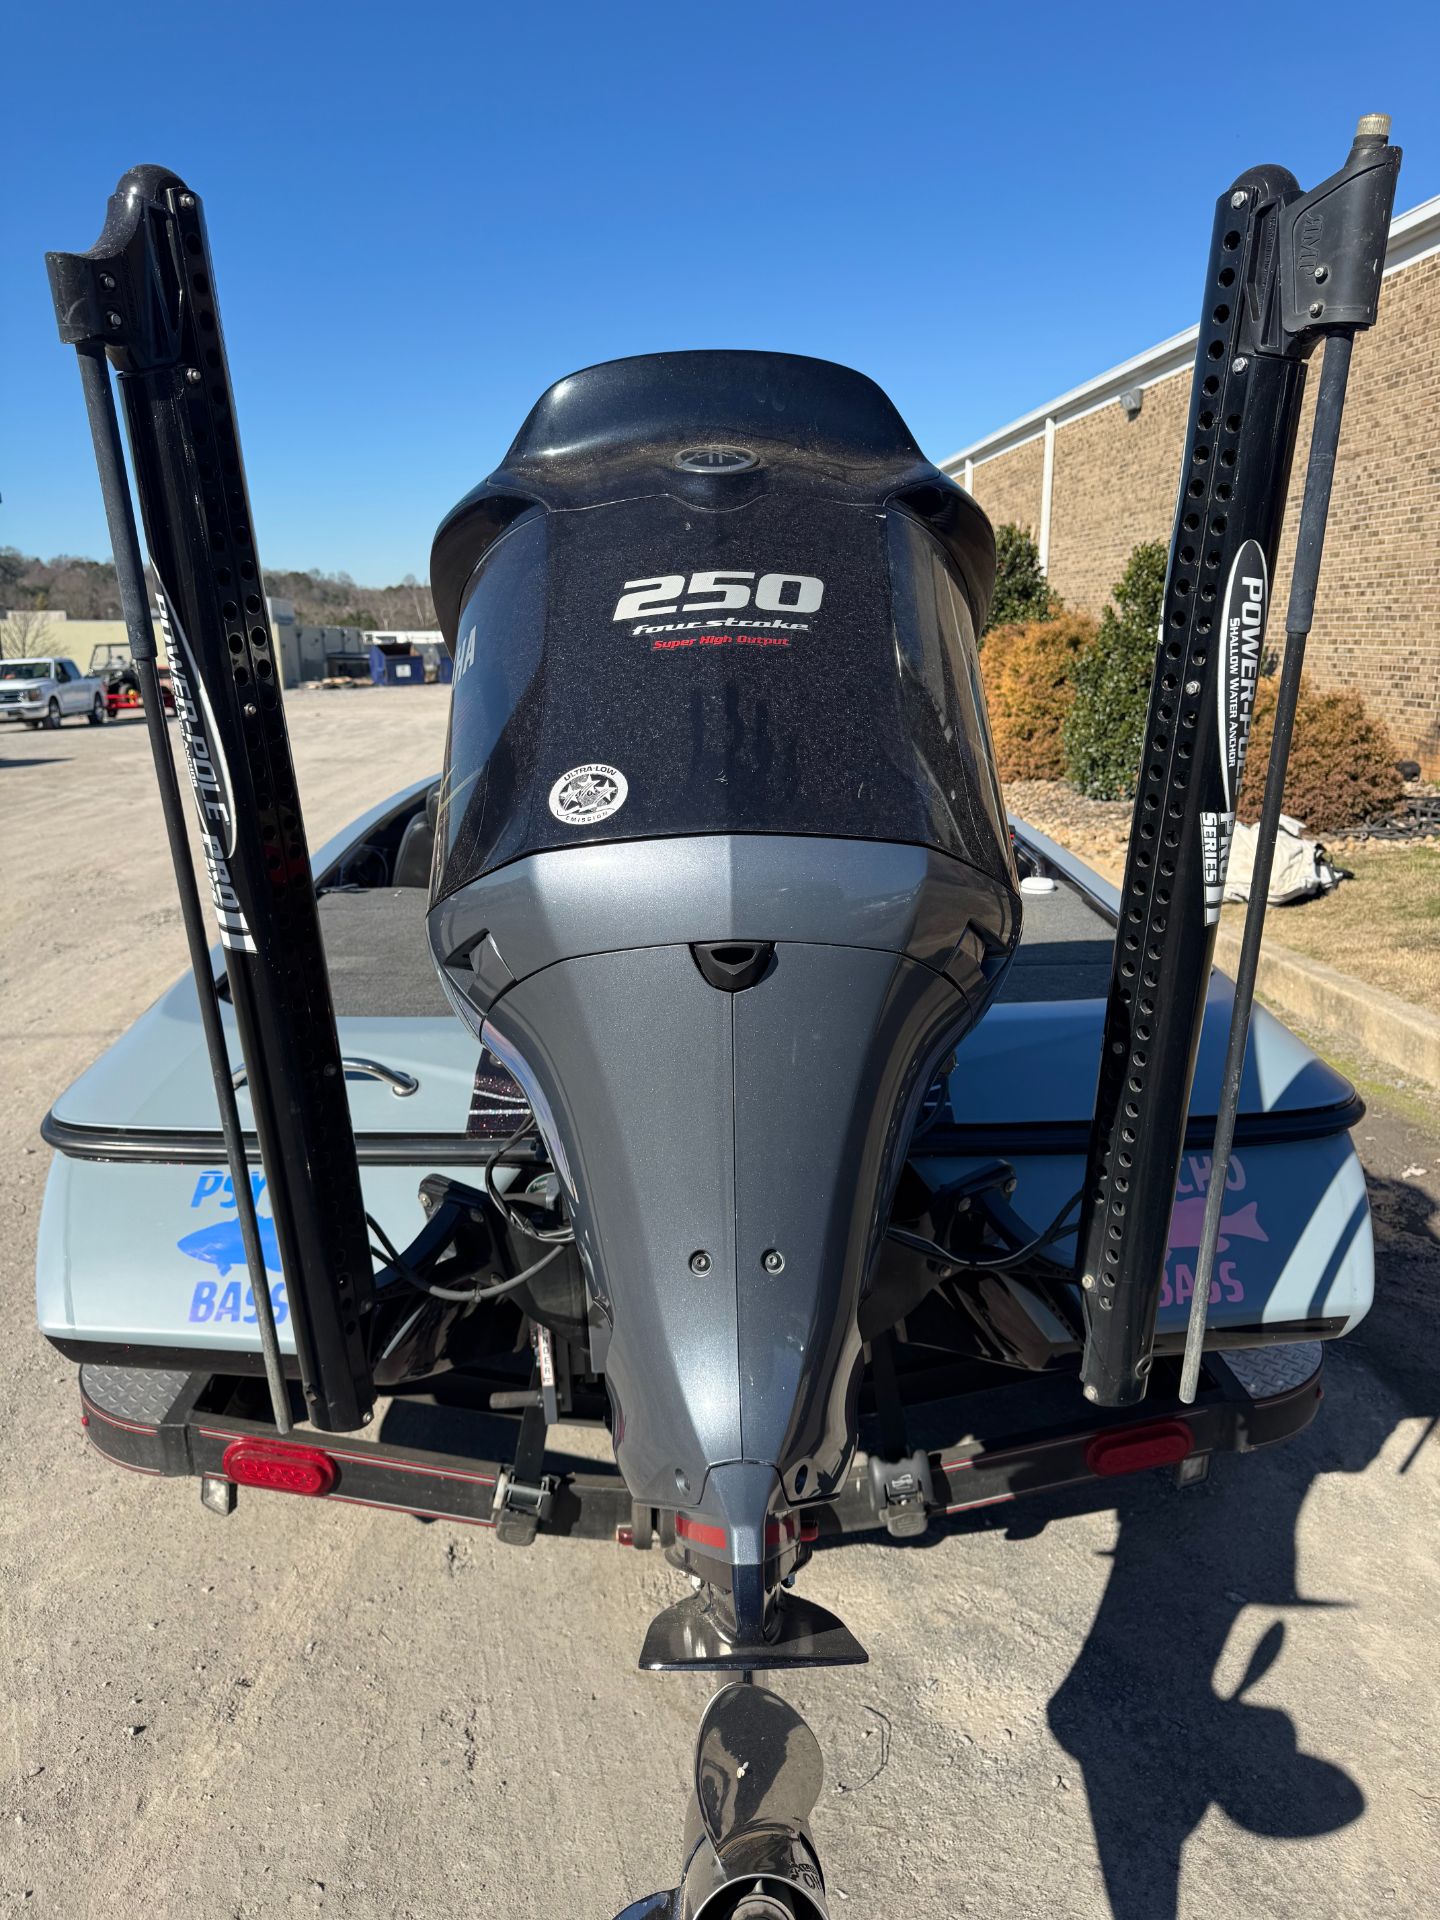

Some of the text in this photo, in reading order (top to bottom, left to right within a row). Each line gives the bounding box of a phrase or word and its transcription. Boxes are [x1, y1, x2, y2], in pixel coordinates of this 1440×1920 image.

[613, 571, 825, 622] 250
[653, 634, 791, 650] Super High Output
[1227, 617, 1241, 768] SHALLOW WATER ANCHOR
[1203, 812, 1218, 884] SERIES
